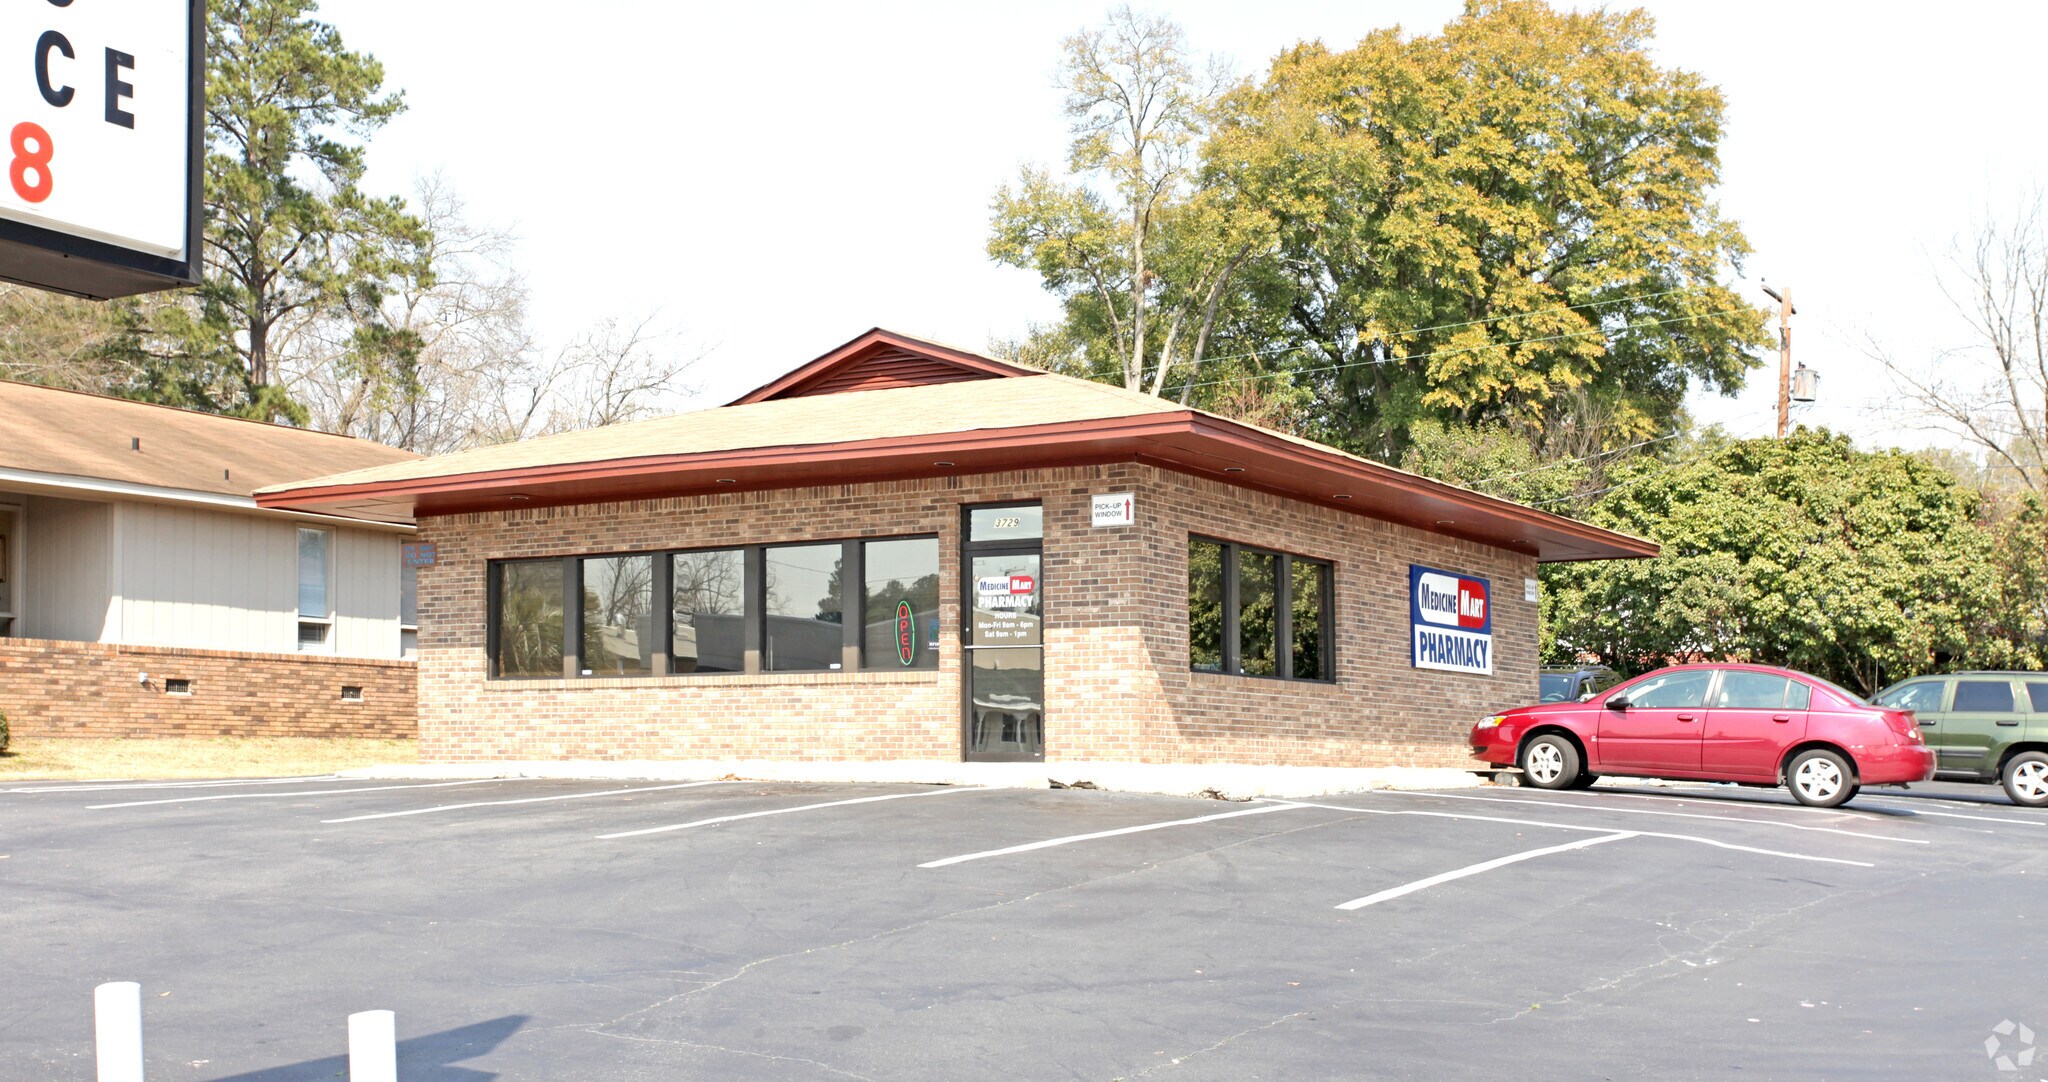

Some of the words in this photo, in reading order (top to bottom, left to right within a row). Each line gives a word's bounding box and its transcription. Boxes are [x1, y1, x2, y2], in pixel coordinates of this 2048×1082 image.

[1095, 502, 1122, 510] PICK-UP
[1095, 510, 1122, 518] WINDOW
[995, 518, 1020, 528] 3729
[980, 581, 1009, 591] MEDICINE
[1011, 579, 1032, 590] MART
[978, 595, 1034, 608] PHARMACY
[1421, 583, 1457, 614] MEDICINE
[1460, 589, 1484, 618] MART
[1020, 621, 1034, 629] 6pm
[899, 605, 911, 659] OPEN
[984, 630, 995, 638] Sat
[995, 630, 1009, 638] 9am
[1014, 630, 1027, 638] 1pm
[1419, 631, 1488, 669] PHARMACY
